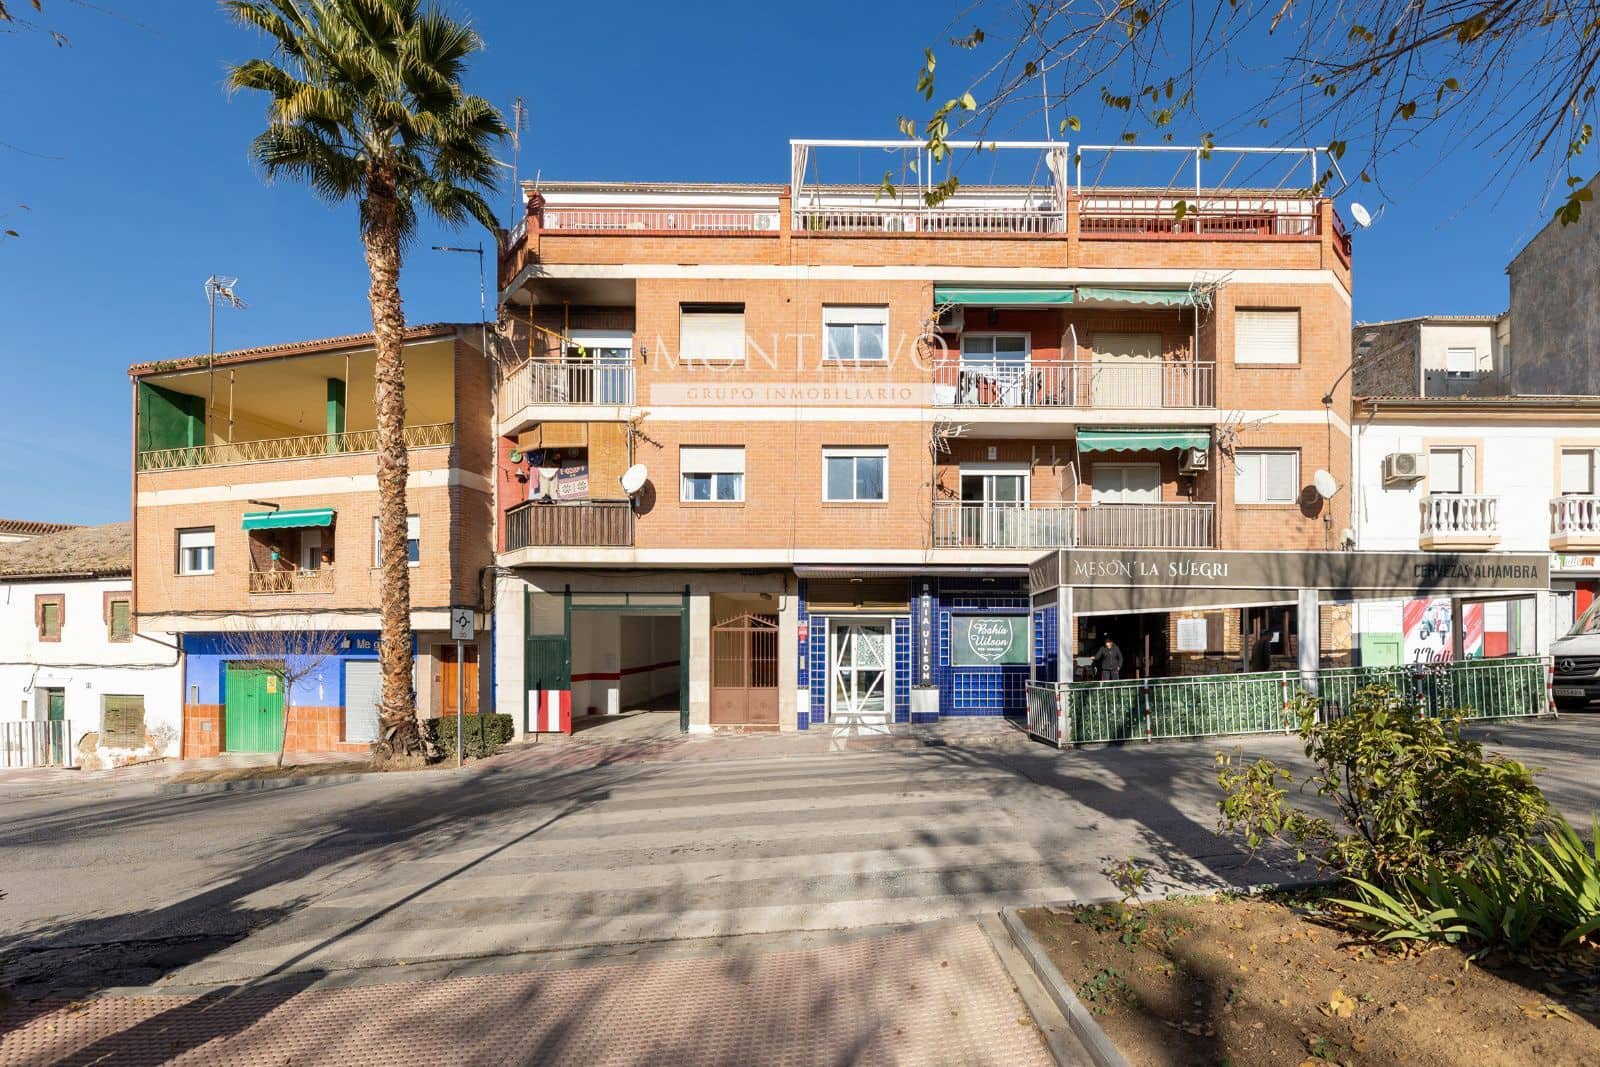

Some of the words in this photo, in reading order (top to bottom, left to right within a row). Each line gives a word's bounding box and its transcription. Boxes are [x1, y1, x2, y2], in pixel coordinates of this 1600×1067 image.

[1140, 563, 1160, 576] LA
[1168, 560, 1229, 579] SUEGRI
[1414, 564, 1470, 578] CERVEZAS
[1474, 565, 1538, 579] ALHAMBRA
[357, 639, 371, 649] Me
[922, 632, 930, 680] UILSON
